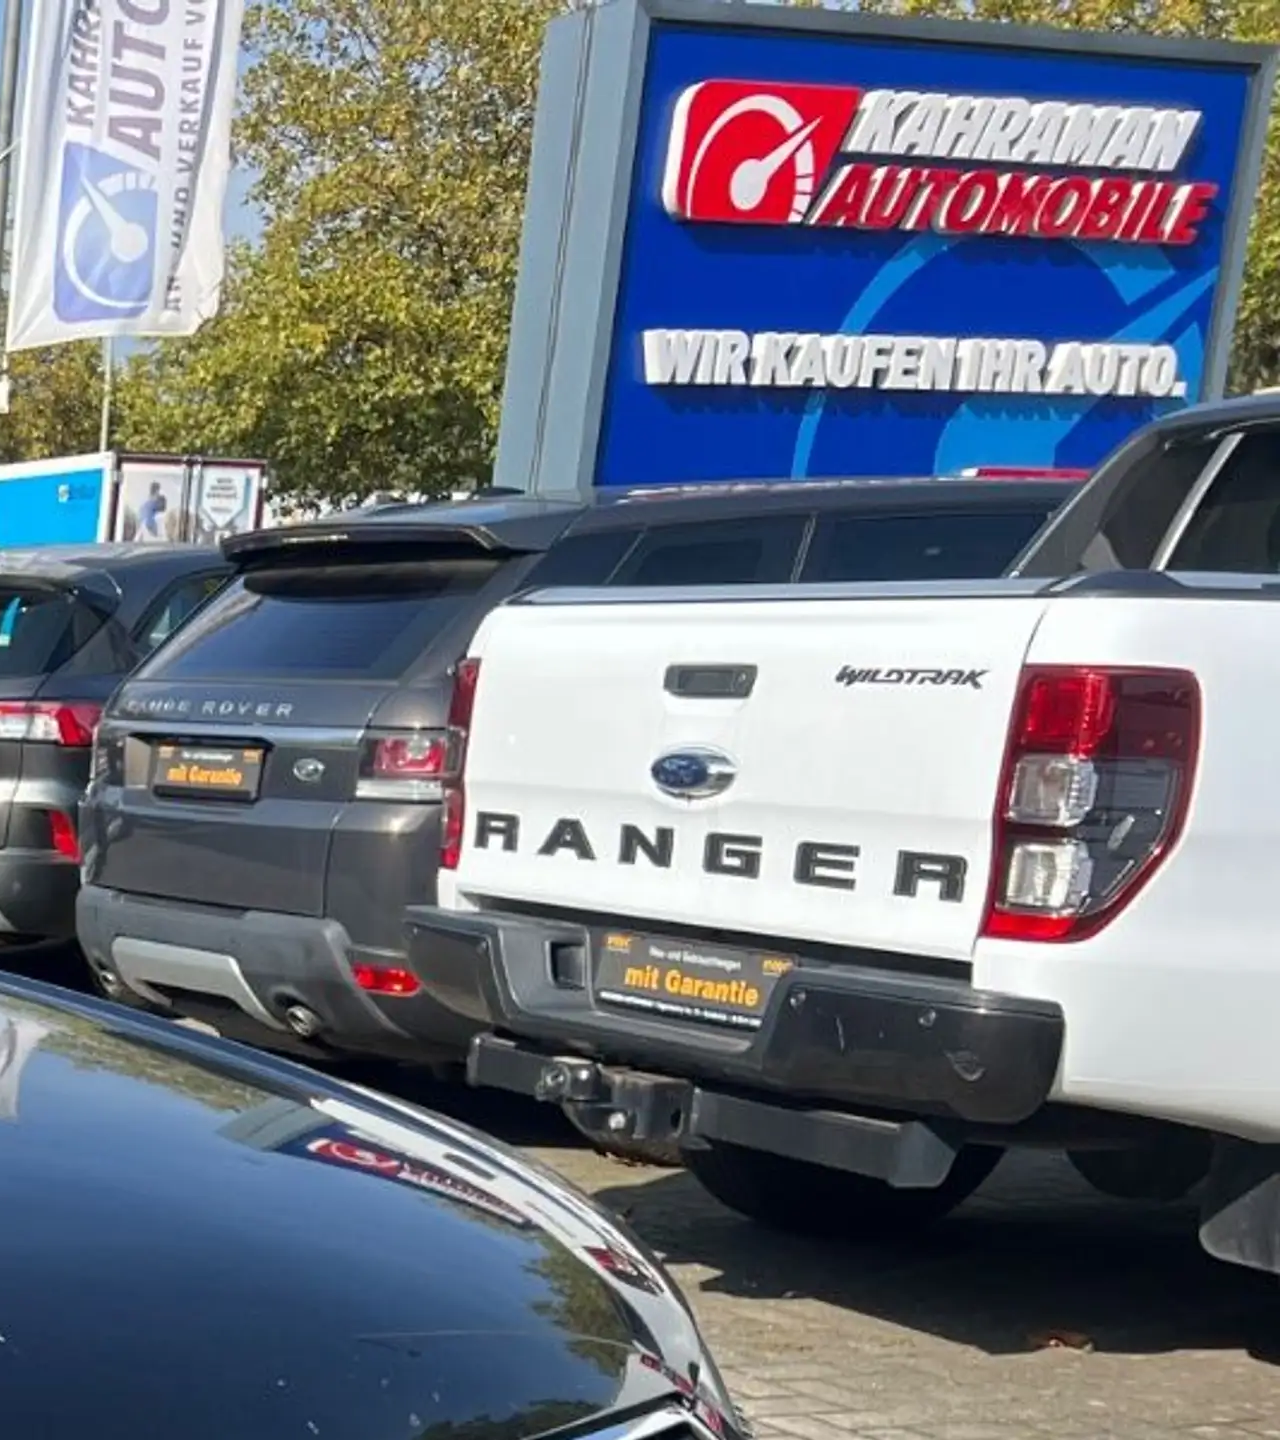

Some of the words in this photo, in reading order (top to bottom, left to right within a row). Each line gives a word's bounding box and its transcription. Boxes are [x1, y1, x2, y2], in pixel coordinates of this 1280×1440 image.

[174, 37, 203, 176] VERKAUF
[842, 89, 1201, 171] KAHRAMAN
[806, 163, 1218, 245] AUTOMOBILE
[643, 329, 755, 385] WIR
[753, 332, 957, 390] KAUFEN
[954, 337, 1052, 394] IHR
[1048, 341, 1187, 397] AUTO.
[201, 700, 294, 718] ROVER
[836, 664, 991, 689] WILDTRAK
[474, 811, 968, 903] RANGER
[624, 964, 660, 990] mit
[664, 968, 760, 1007] Garantie
